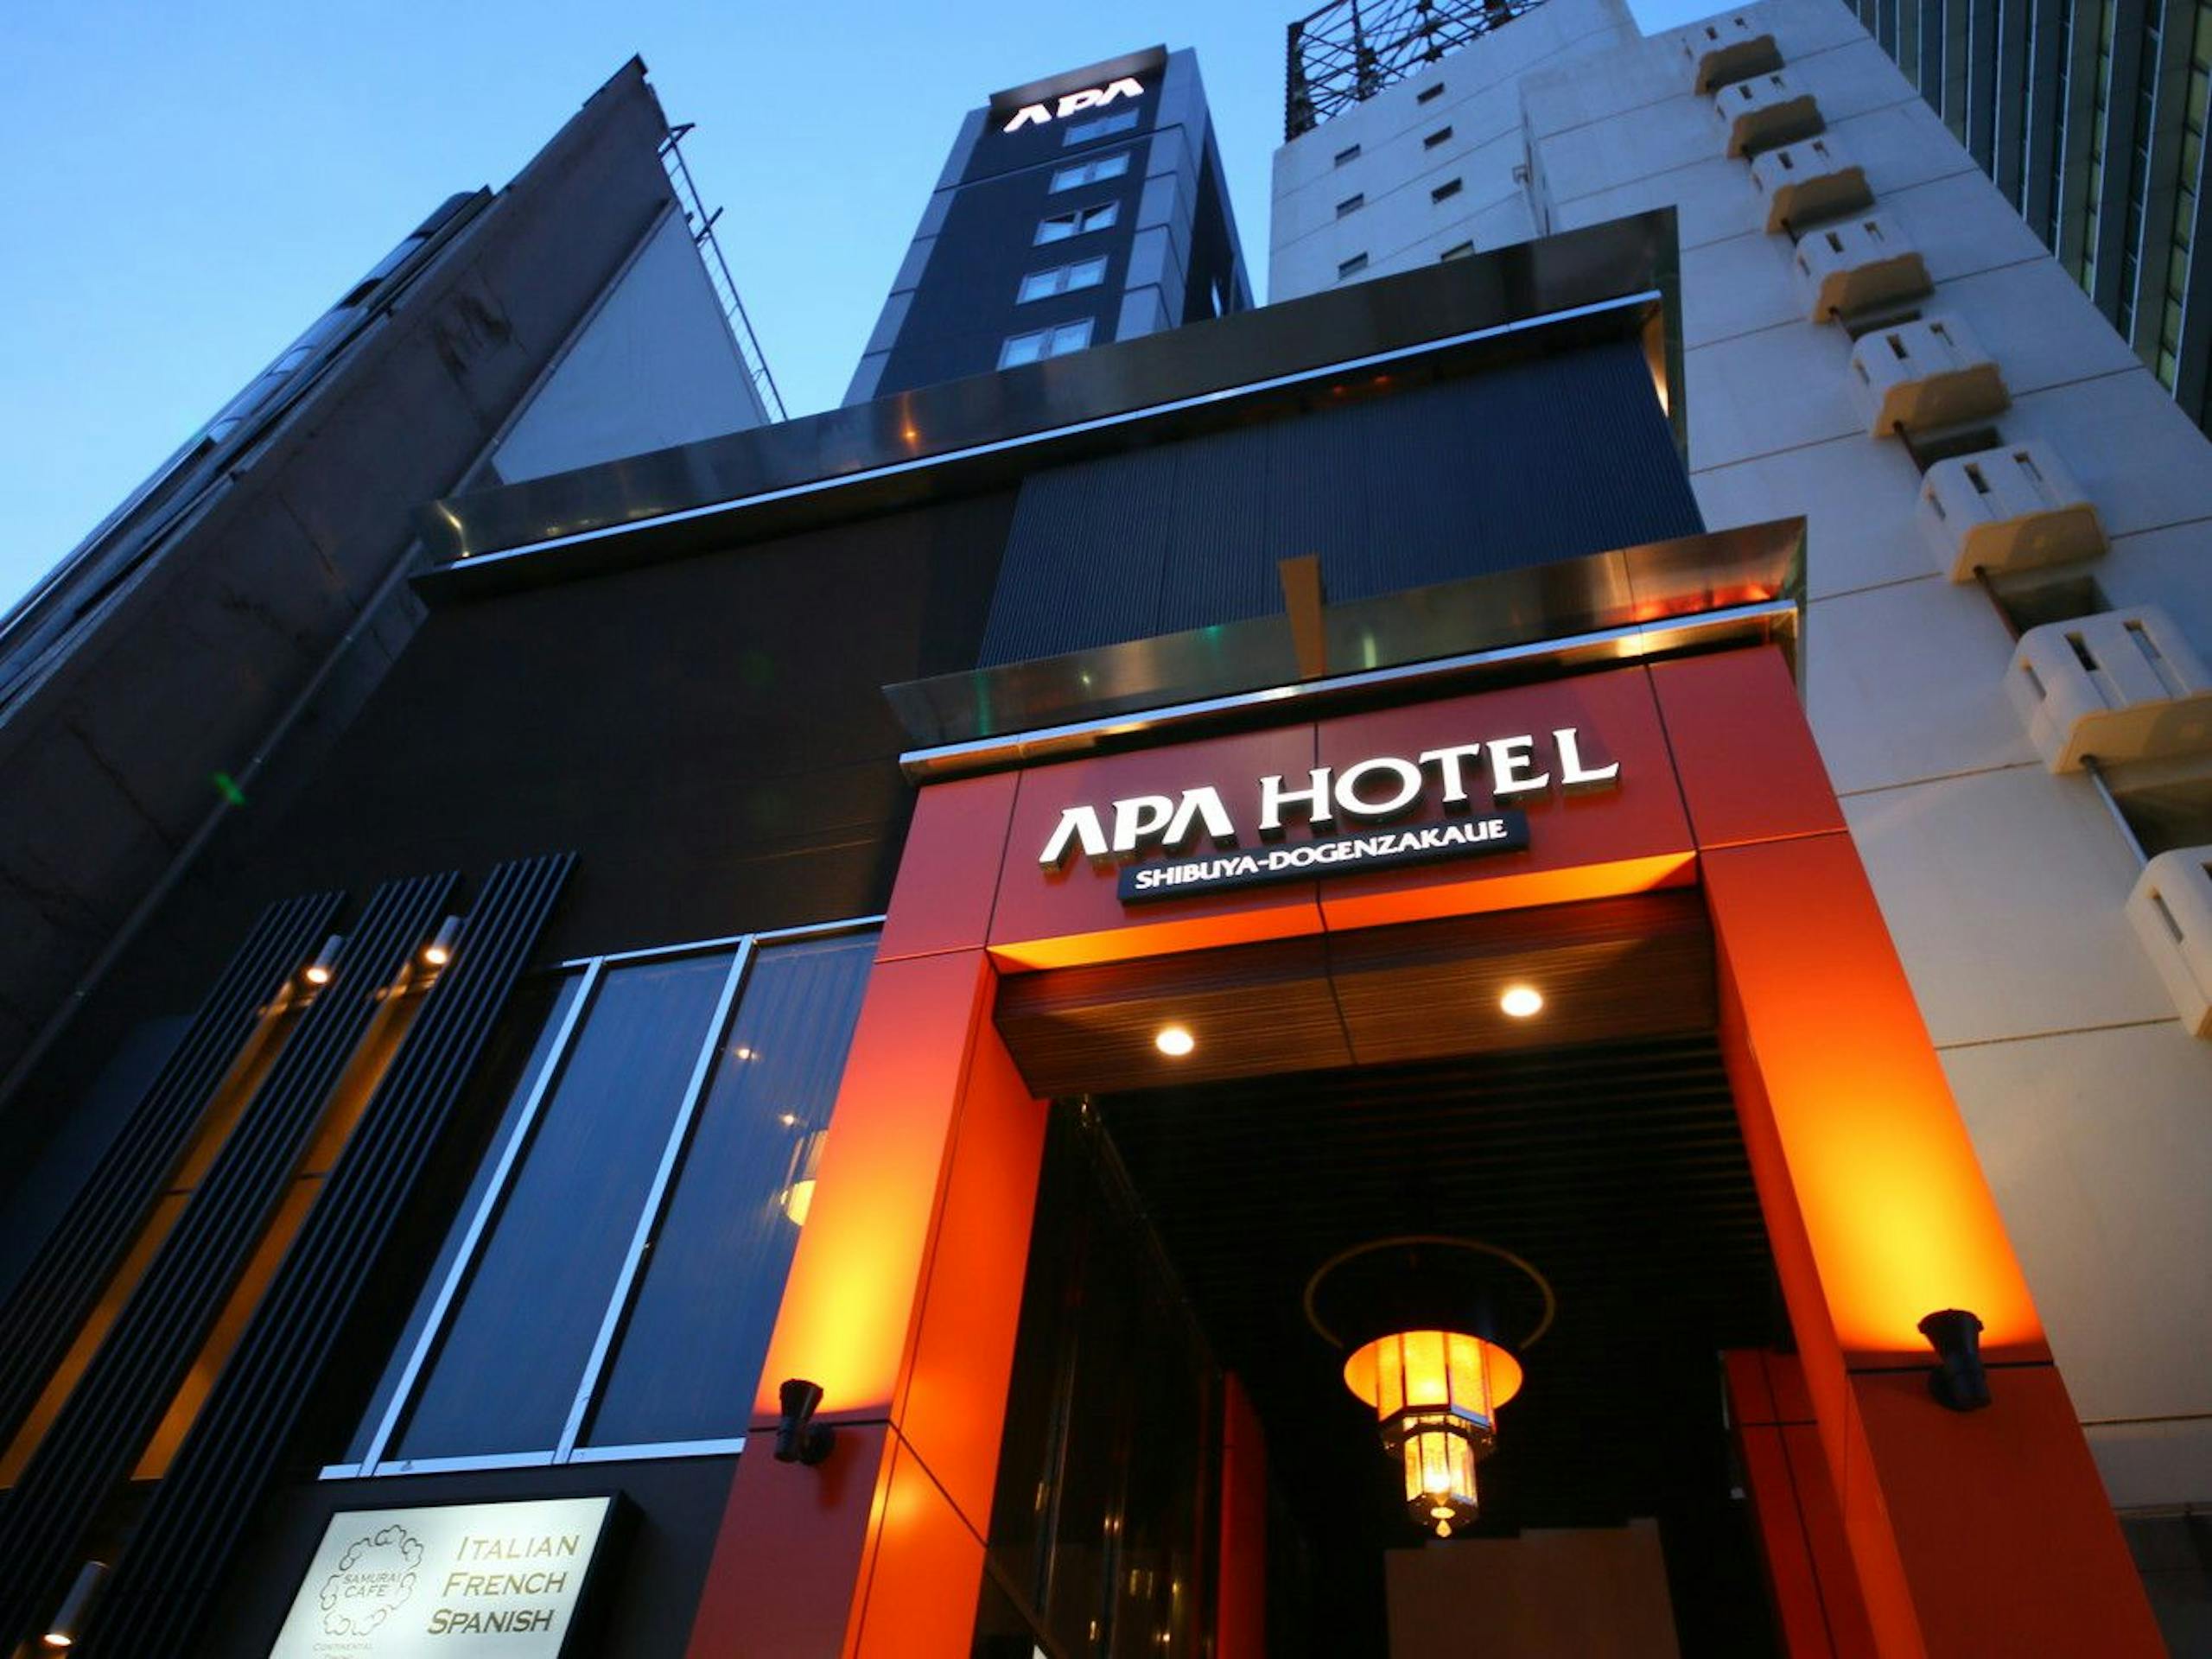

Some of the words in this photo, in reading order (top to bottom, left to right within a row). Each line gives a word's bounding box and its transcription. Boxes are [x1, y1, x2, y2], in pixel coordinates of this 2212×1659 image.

[1002, 76, 1145, 132] APA
[1039, 786, 1235, 864] APA
[1259, 728, 1620, 830] HOTEL
[456, 1535, 580, 1561] ITALIAN
[344, 1572, 403, 1585] SAMURAI
[442, 1572, 568, 1598] FRENCH
[427, 1608, 555, 1635] SPANISH
